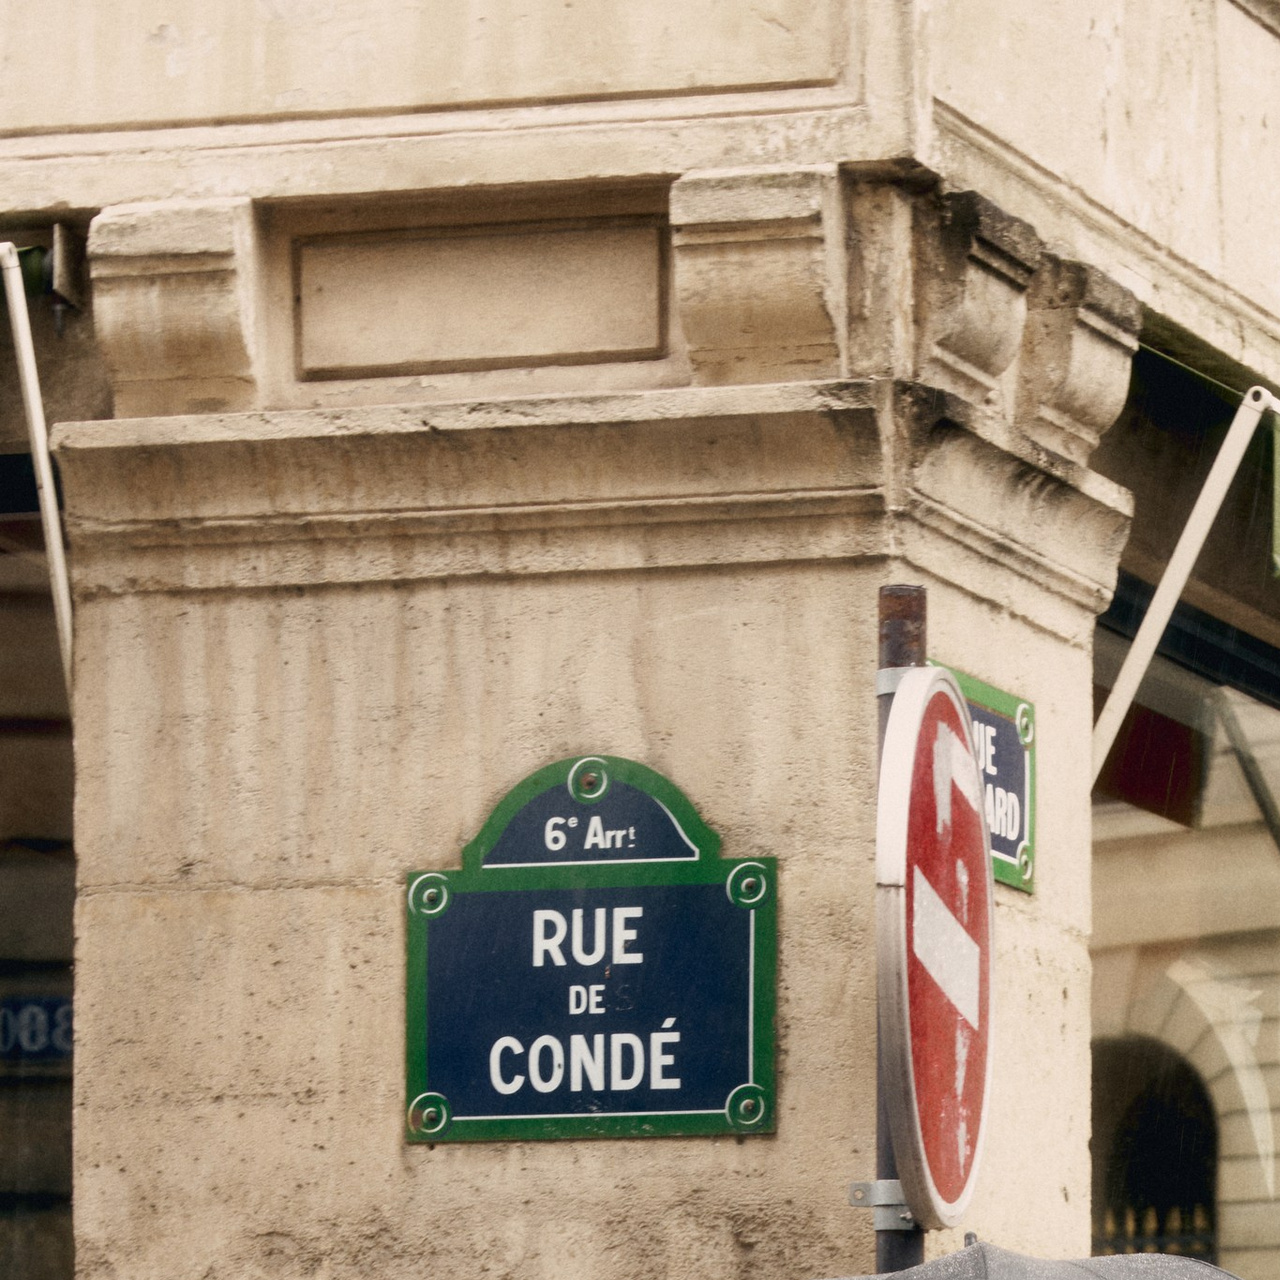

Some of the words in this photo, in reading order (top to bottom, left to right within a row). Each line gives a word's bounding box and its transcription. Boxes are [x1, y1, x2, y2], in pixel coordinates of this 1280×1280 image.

[973, 720, 998, 776] UE
[985, 783, 1020, 841] ARD
[532, 906, 645, 967] RUE
[568, 984, 607, 1016] DE
[488, 1017, 682, 1095] CONDÉ
